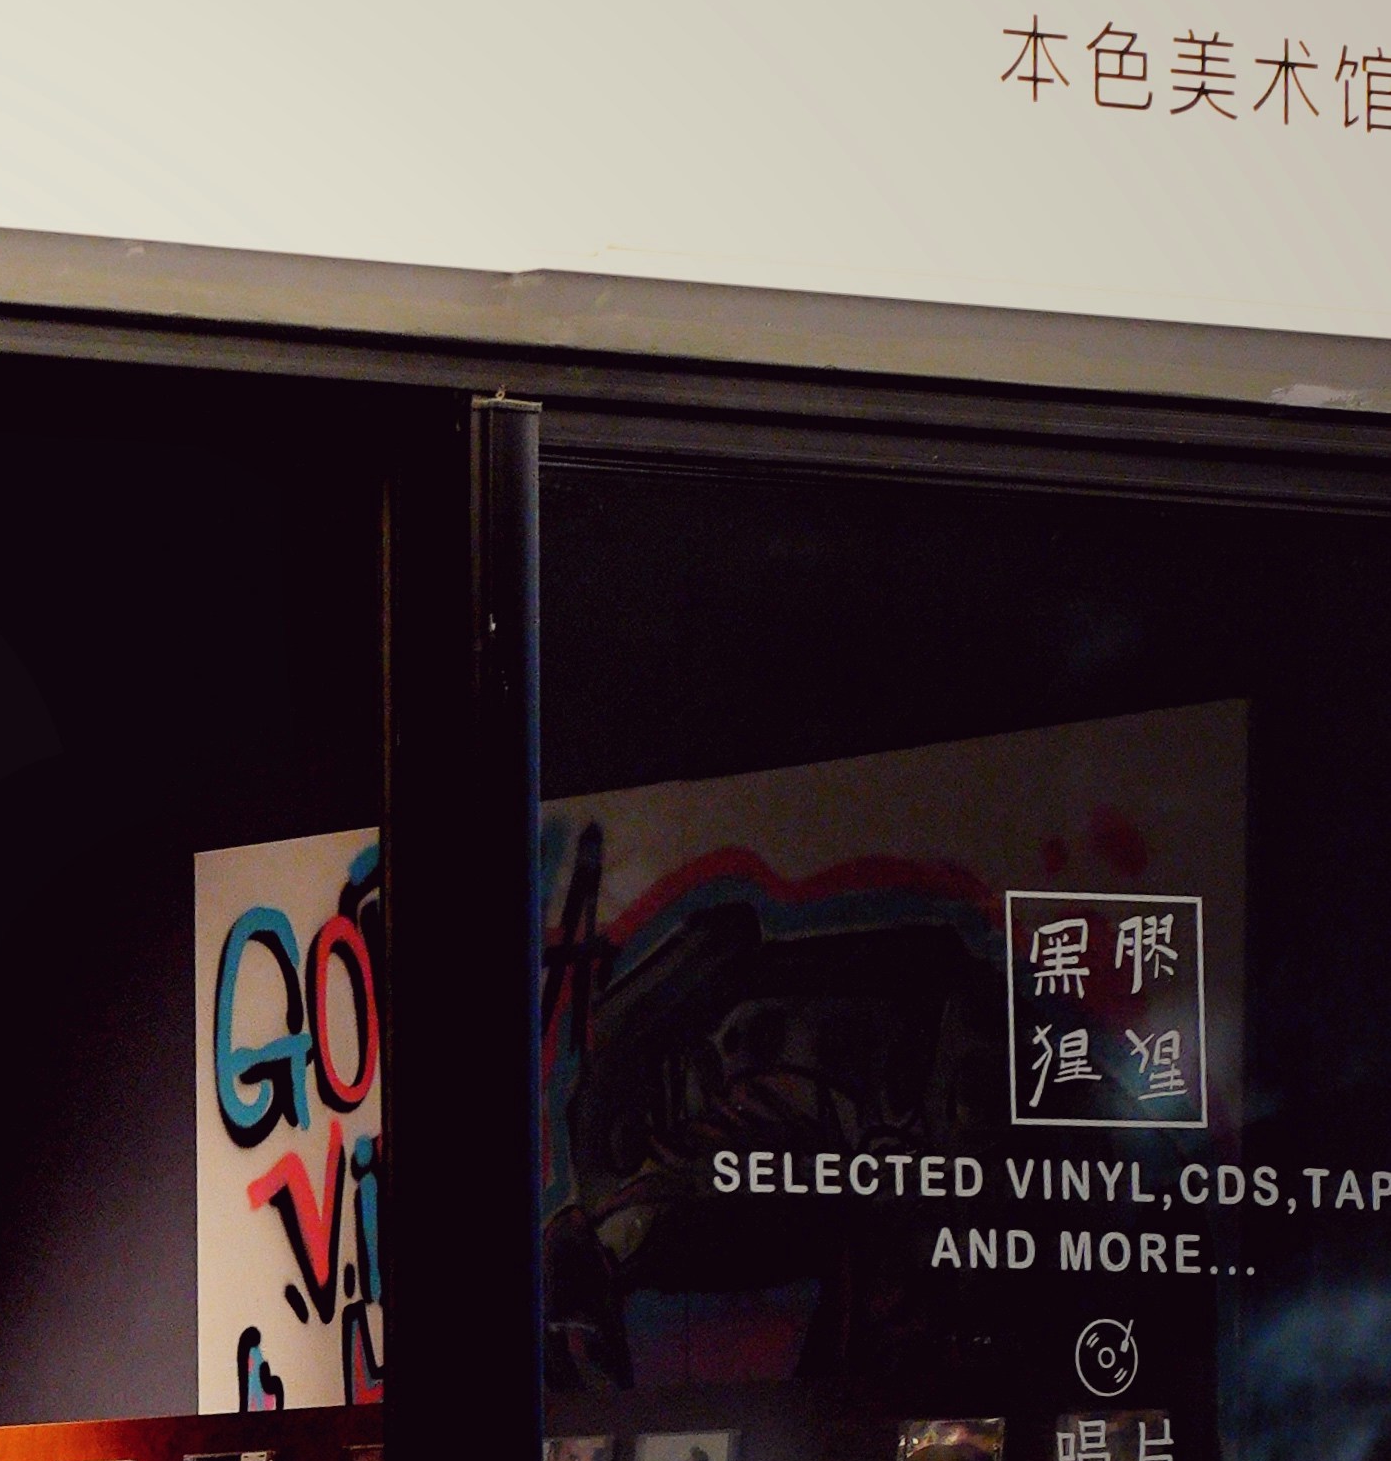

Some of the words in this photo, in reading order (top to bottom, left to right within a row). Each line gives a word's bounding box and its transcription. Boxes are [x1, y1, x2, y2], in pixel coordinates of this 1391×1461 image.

[1000, 13, 1391, 134] 本色美术馆
[1026, 1024, 1189, 1108] 猩猩
[712, 1149, 986, 1199] SELECTED
[931, 1226, 1037, 1270] AND
